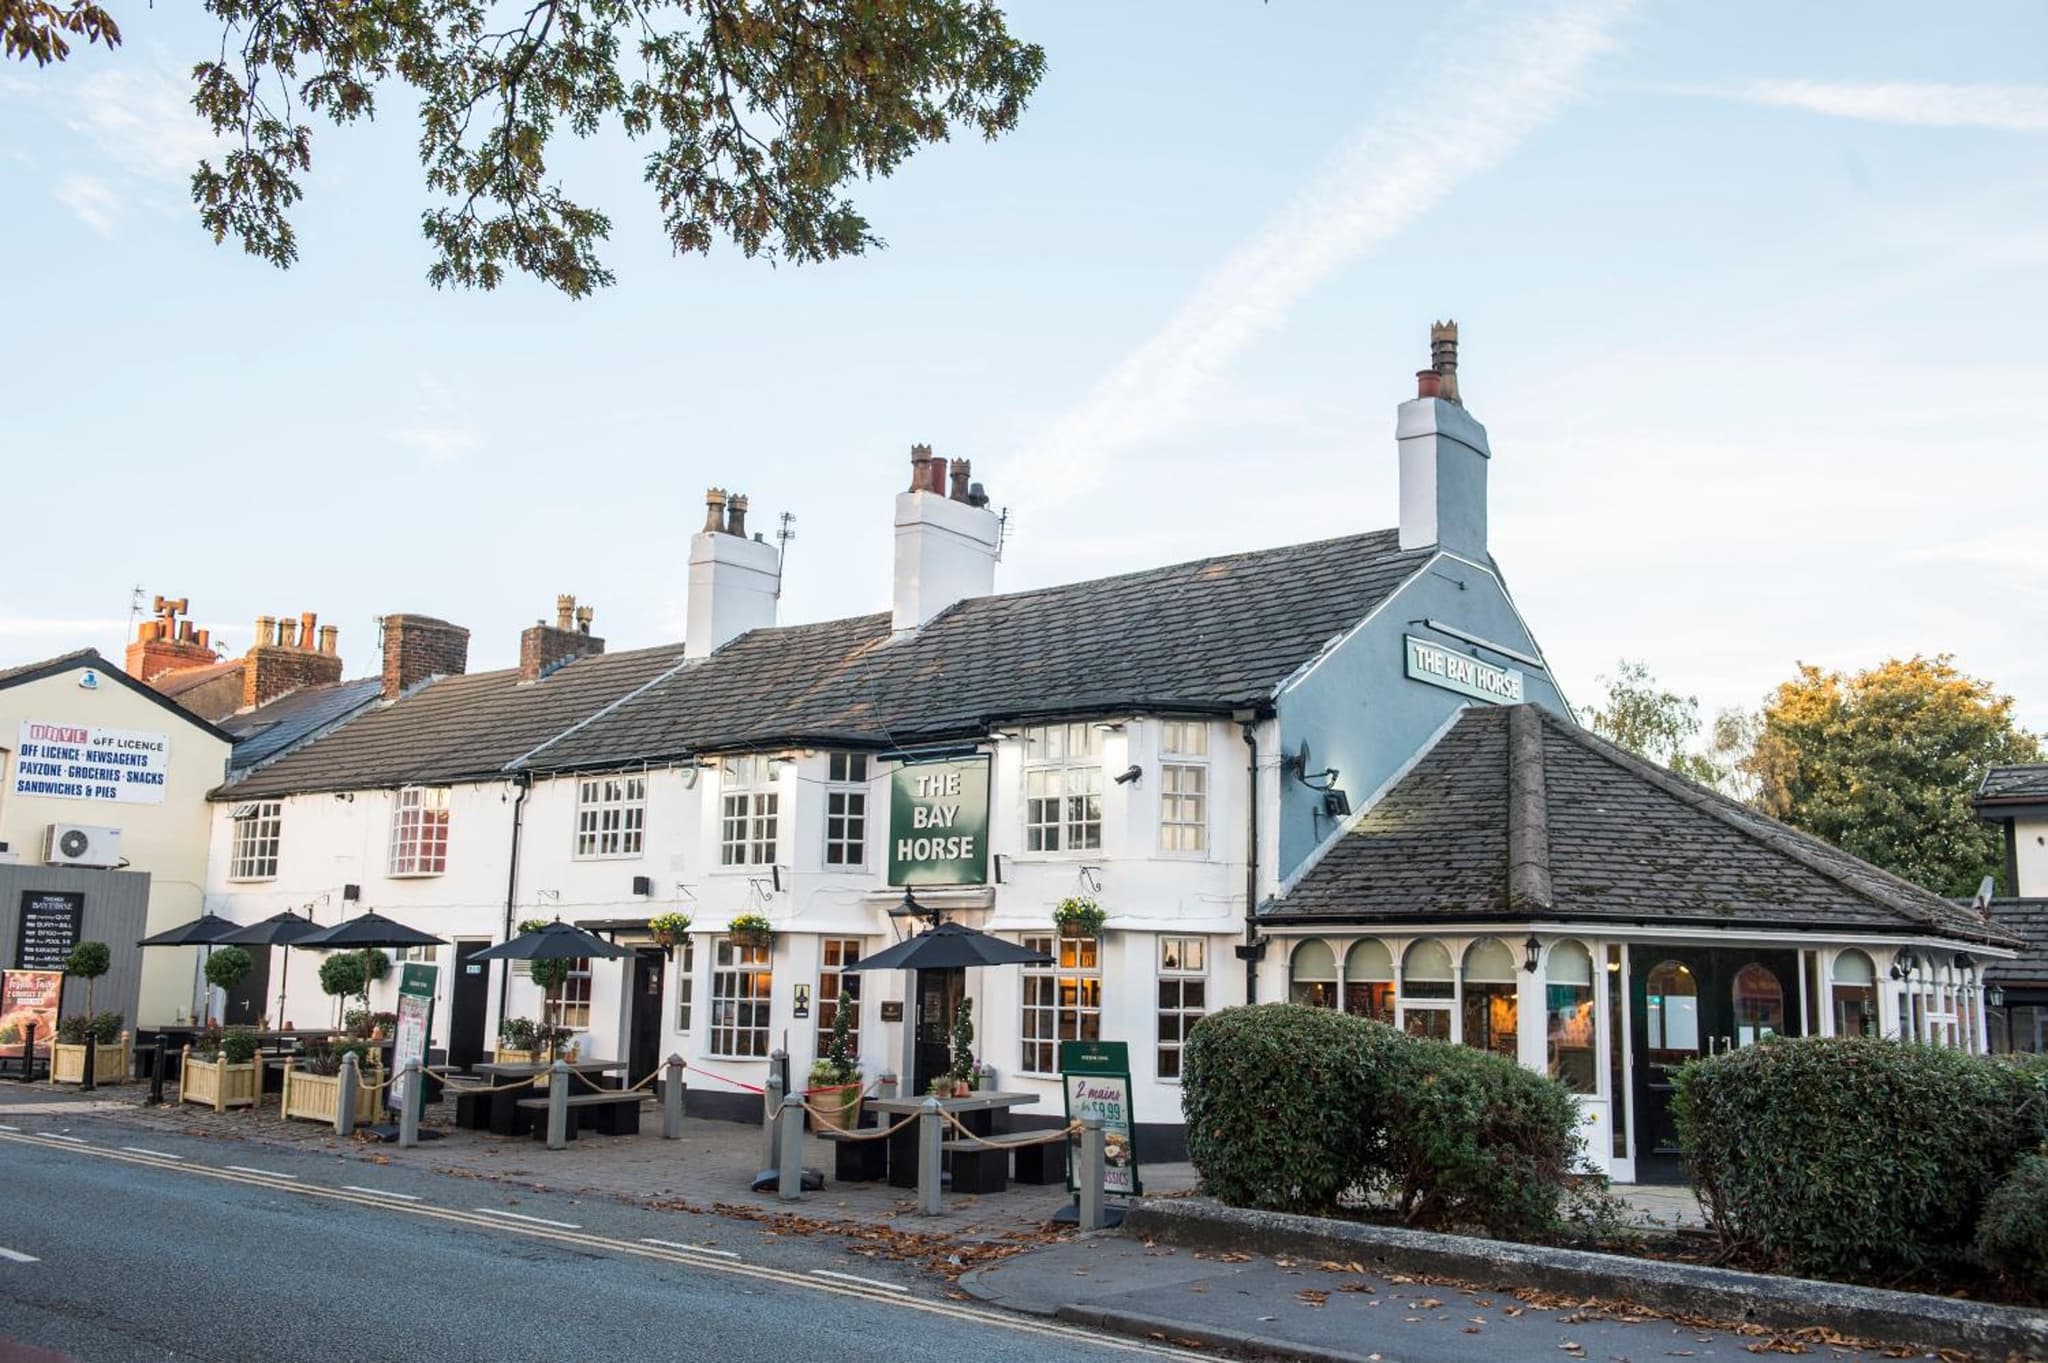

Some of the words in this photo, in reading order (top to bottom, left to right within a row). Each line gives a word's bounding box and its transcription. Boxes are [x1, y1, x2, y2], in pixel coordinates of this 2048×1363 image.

[1415, 646, 1443, 676] THE
[1446, 656, 1473, 685] BAY
[1475, 666, 1520, 700] HORSE
[21, 744, 38, 756] OFF
[41, 746, 80, 761] LICENCE
[86, 749, 148, 767] NEWSAGENTS
[118, 739, 163, 751] LICENCE
[19, 761, 62, 776] PAYZONE
[68, 765, 120, 782] GROCERIES
[126, 773, 164, 785] SNACKS
[17, 780, 82, 796] SANDWICHES
[85, 785, 92, 796] &
[95, 786, 116, 798] PIES
[916, 773, 960, 798] THE
[913, 805, 959, 829] BAY
[898, 836, 974, 861] HORSE
[1076, 1081, 1086, 1098] 2
[1088, 1087, 1121, 1100] mains
